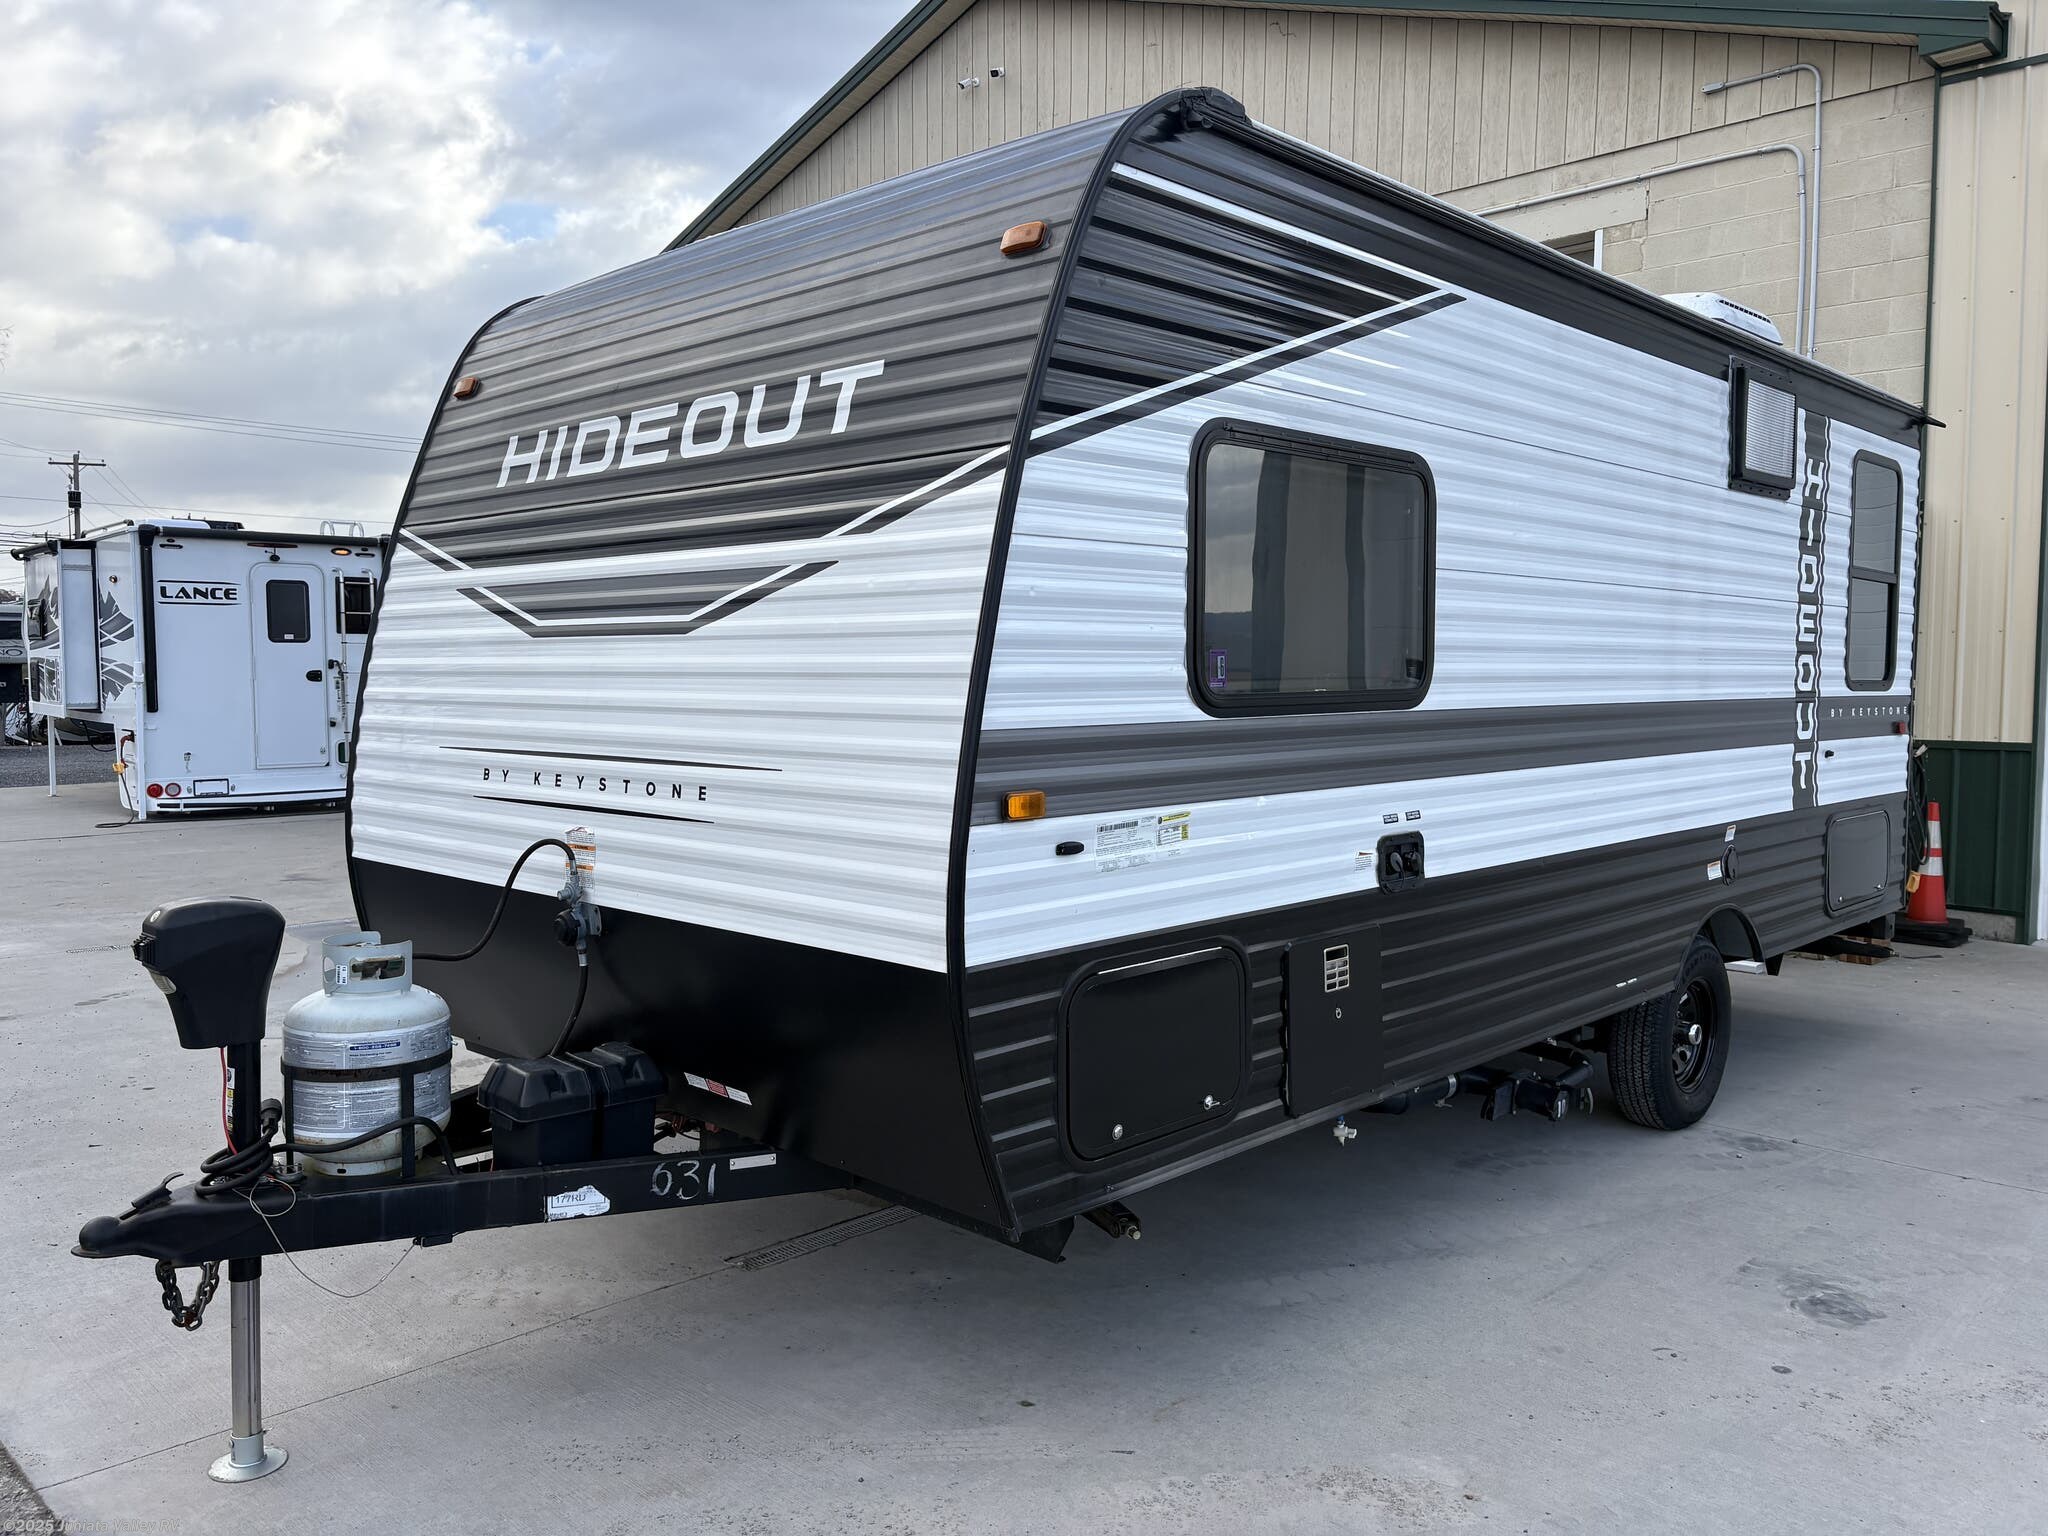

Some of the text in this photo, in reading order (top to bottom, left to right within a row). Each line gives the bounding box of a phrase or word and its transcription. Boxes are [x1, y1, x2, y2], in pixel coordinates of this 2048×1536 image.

[496, 359, 886, 488] HIDEOUT
[159, 585, 239, 601] LANCE
[1794, 458, 1825, 790] HIDEOUT
[1830, 706, 1908, 718] BY KEYSTONE
[483, 767, 707, 801] BY KEYSTONE
